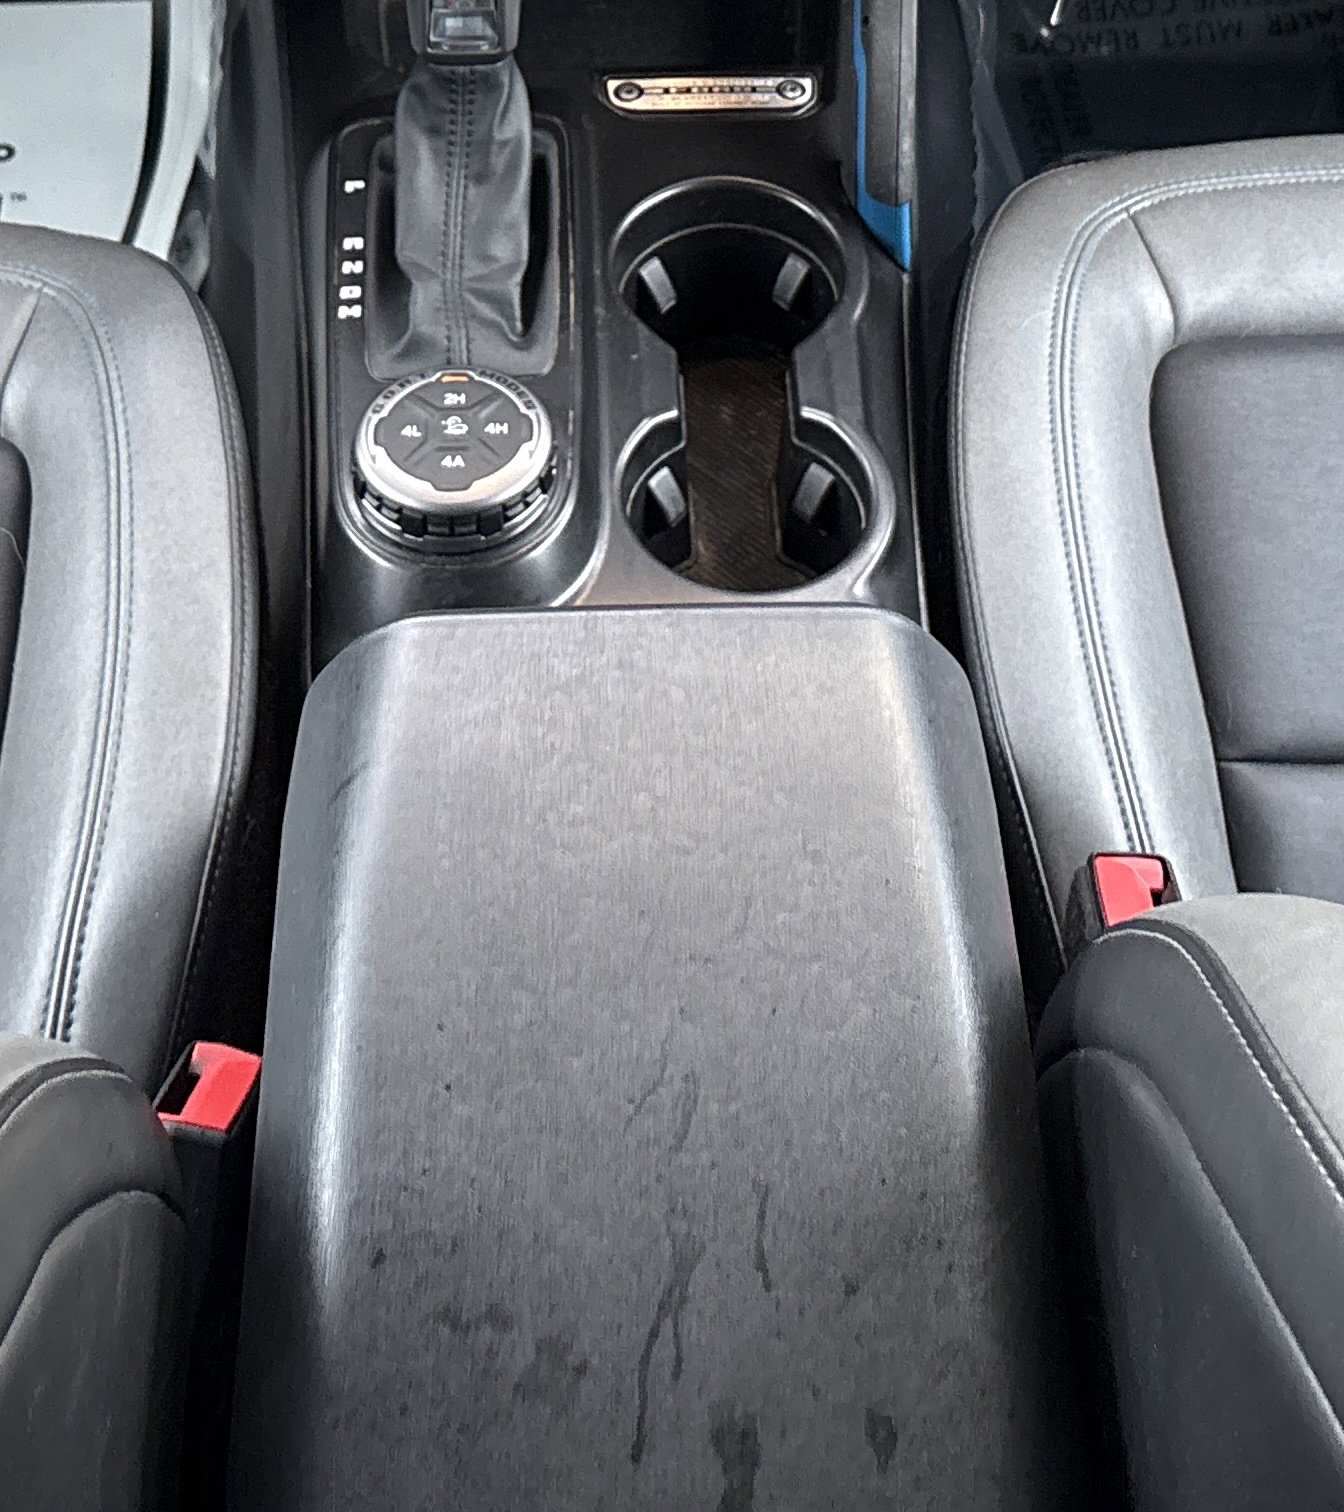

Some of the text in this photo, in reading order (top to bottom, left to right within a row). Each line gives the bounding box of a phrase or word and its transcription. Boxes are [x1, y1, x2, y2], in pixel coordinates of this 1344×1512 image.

[443, 393, 466, 405] 2H
[400, 425, 422, 437] 4L
[484, 422, 509, 435] 4H
[440, 455, 465, 468] 4A
